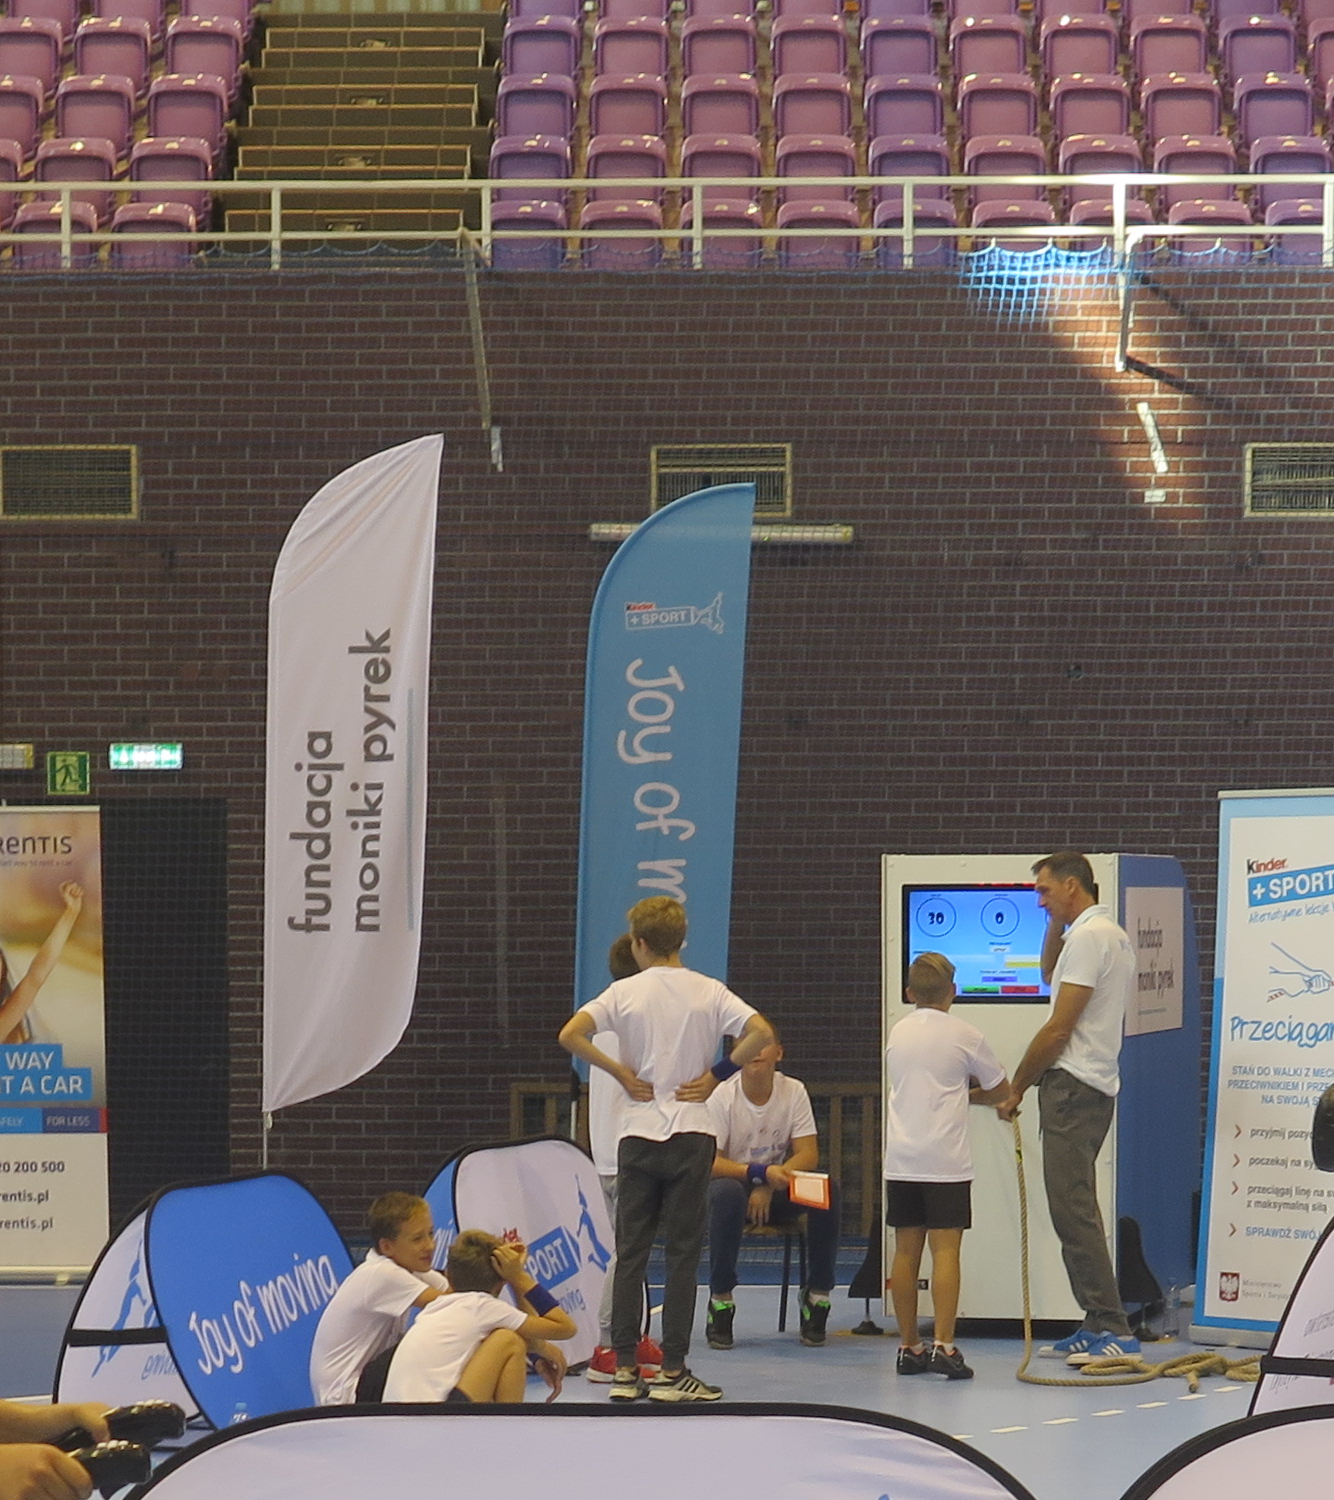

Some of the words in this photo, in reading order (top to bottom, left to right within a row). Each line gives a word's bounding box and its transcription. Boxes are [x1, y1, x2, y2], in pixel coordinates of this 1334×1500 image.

[641, 609, 688, 625] SPORT
[347, 627, 396, 762] pyrek
[617, 657, 685, 765] Joy
[287, 730, 345, 934] fundacja
[633, 781, 696, 841] of
[345, 781, 385, 933] moniki
[927, 911, 945, 926] 30
[5, 1051, 55, 1071] WAY
[20, 1075, 36, 1094] A
[41, 1075, 84, 1095] CAR
[46, 1115, 66, 1127] FOR
[67, 1115, 91, 1127] LESS
[13, 1161, 38, 1174] 200
[40, 1161, 66, 1174] 500
[524, 1237, 570, 1283] PORT
[188, 1310, 244, 1375] Joy
[233, 1279, 264, 1348] of
